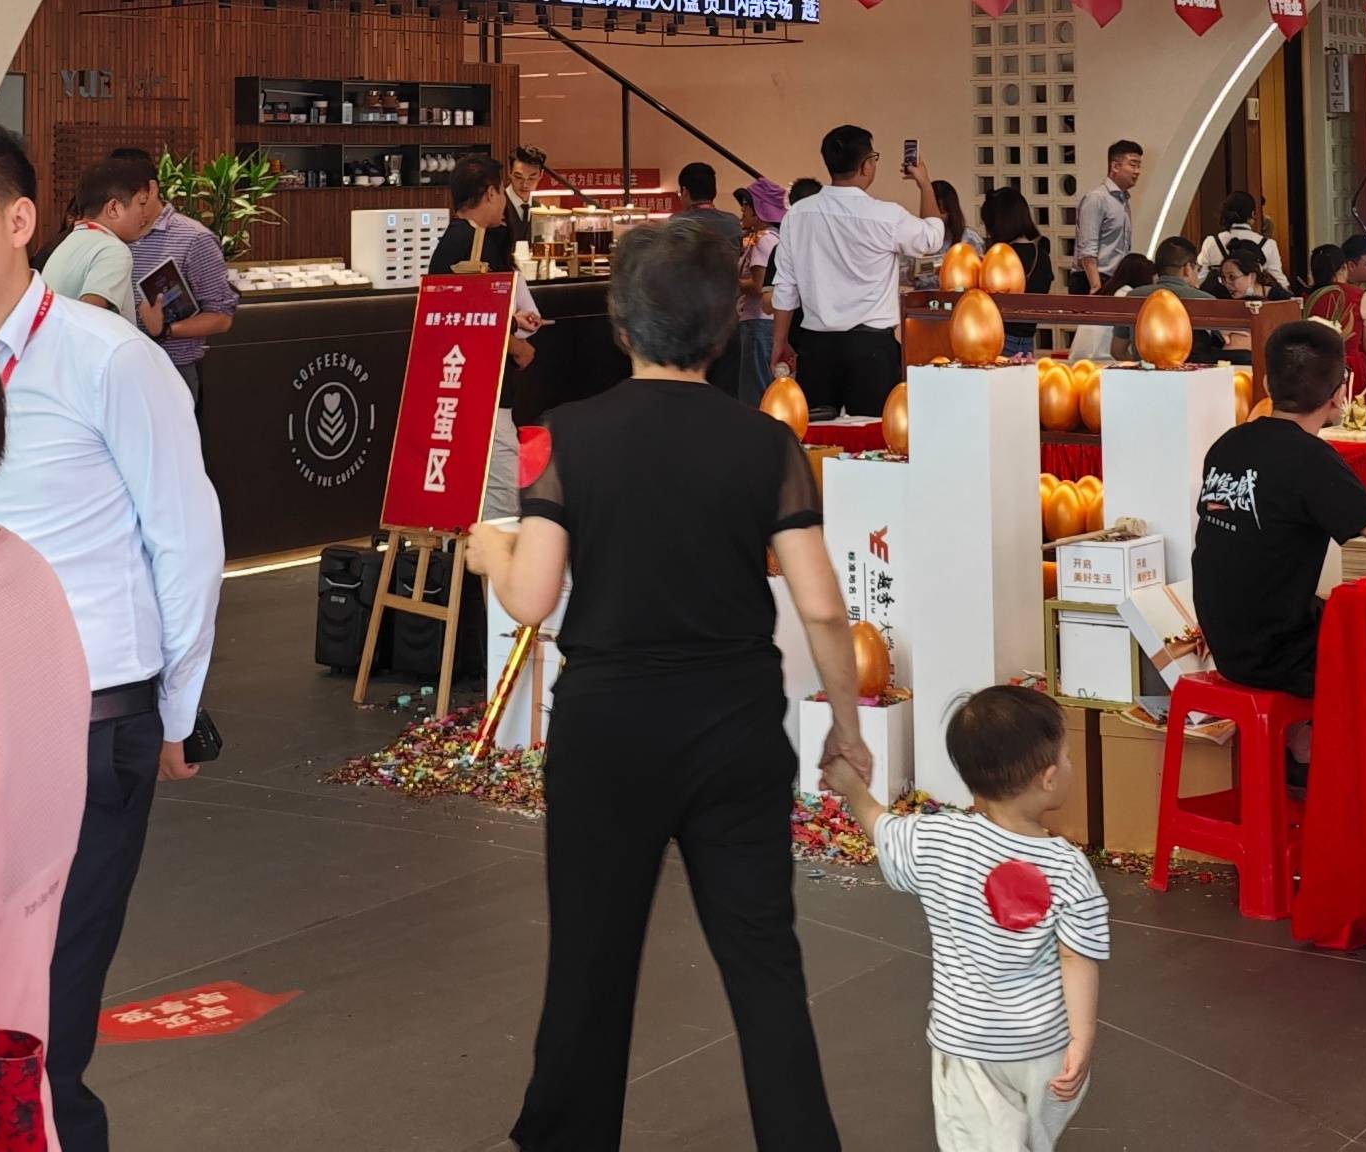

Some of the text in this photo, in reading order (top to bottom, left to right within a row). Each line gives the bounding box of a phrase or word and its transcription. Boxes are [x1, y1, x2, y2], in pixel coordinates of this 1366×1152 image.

[293, 352, 369, 390] COFFEESHOP
[423, 344, 466, 493] 金蛋区
